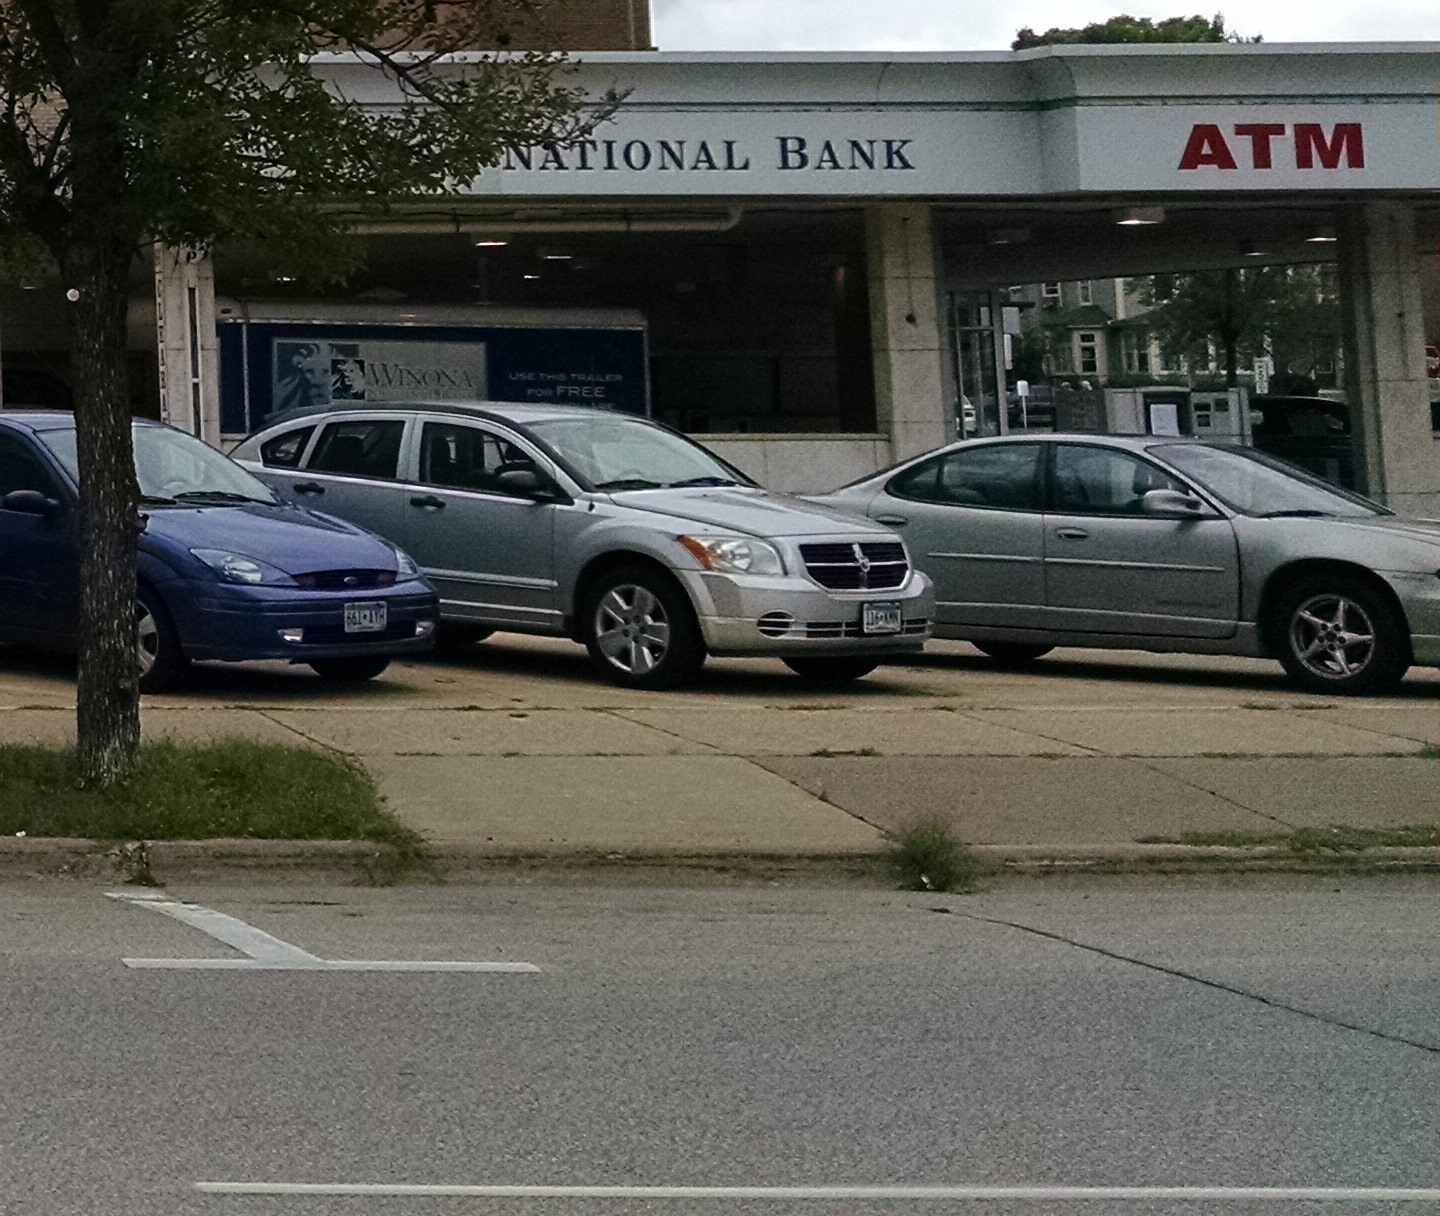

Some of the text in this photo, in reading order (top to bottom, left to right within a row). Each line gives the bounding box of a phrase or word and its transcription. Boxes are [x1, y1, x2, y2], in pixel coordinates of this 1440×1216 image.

[502, 136, 916, 171] NATIONAL BANK
[1176, 123, 1365, 170] ATM
[367, 362, 474, 388] WINONA
[556, 385, 606, 398] FREE
